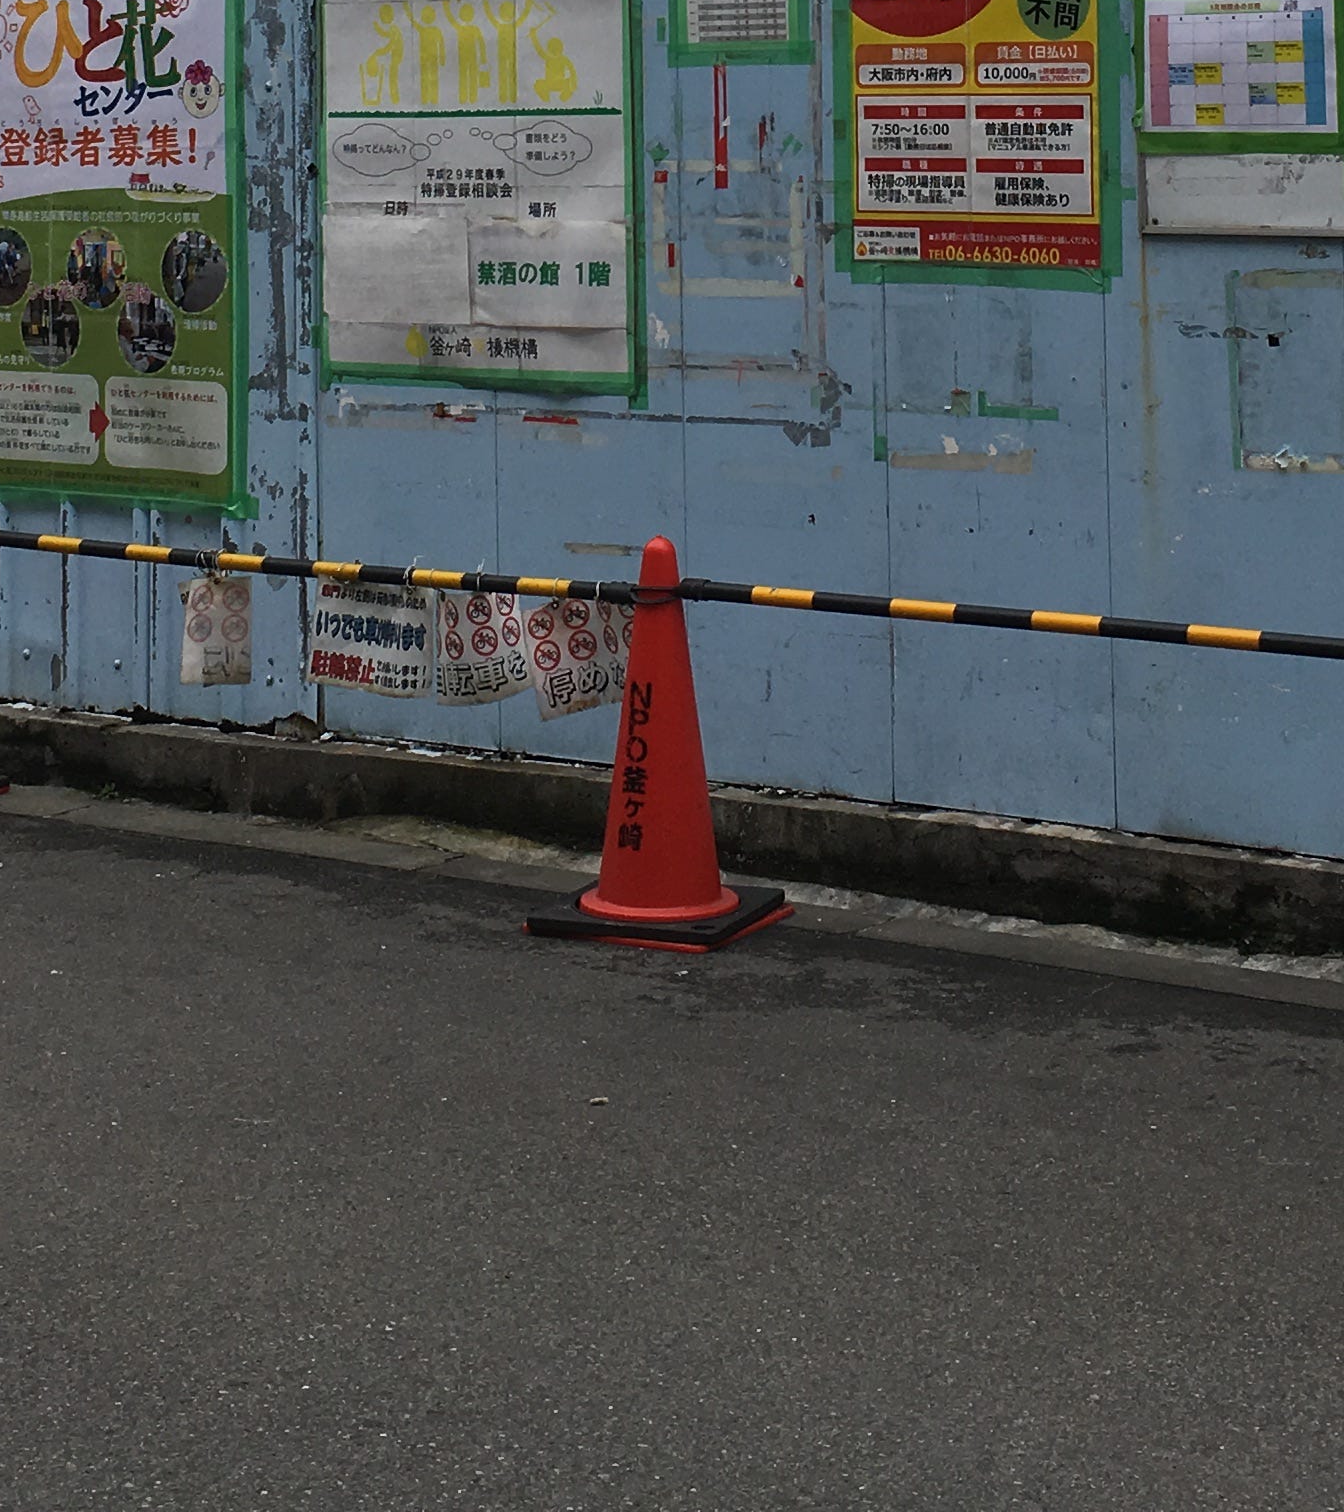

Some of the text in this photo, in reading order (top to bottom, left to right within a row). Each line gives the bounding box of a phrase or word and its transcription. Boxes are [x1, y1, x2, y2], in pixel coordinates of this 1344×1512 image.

[868, 66, 952, 82] 大阪市内・府内
[74, 82, 174, 117] センター
[984, 122, 1074, 137] 普通自動車免許
[0, 123, 197, 168] 登録者募集！
[867, 173, 966, 189] 特掃の現場指導員
[420, 182, 513, 199] 特掃登録相談会
[384, 201, 409, 216] 日時
[994, 193, 1071, 208] 健康保険あり
[528, 202, 556, 218] 場所
[477, 261, 611, 287] 禁酒の館 1階
